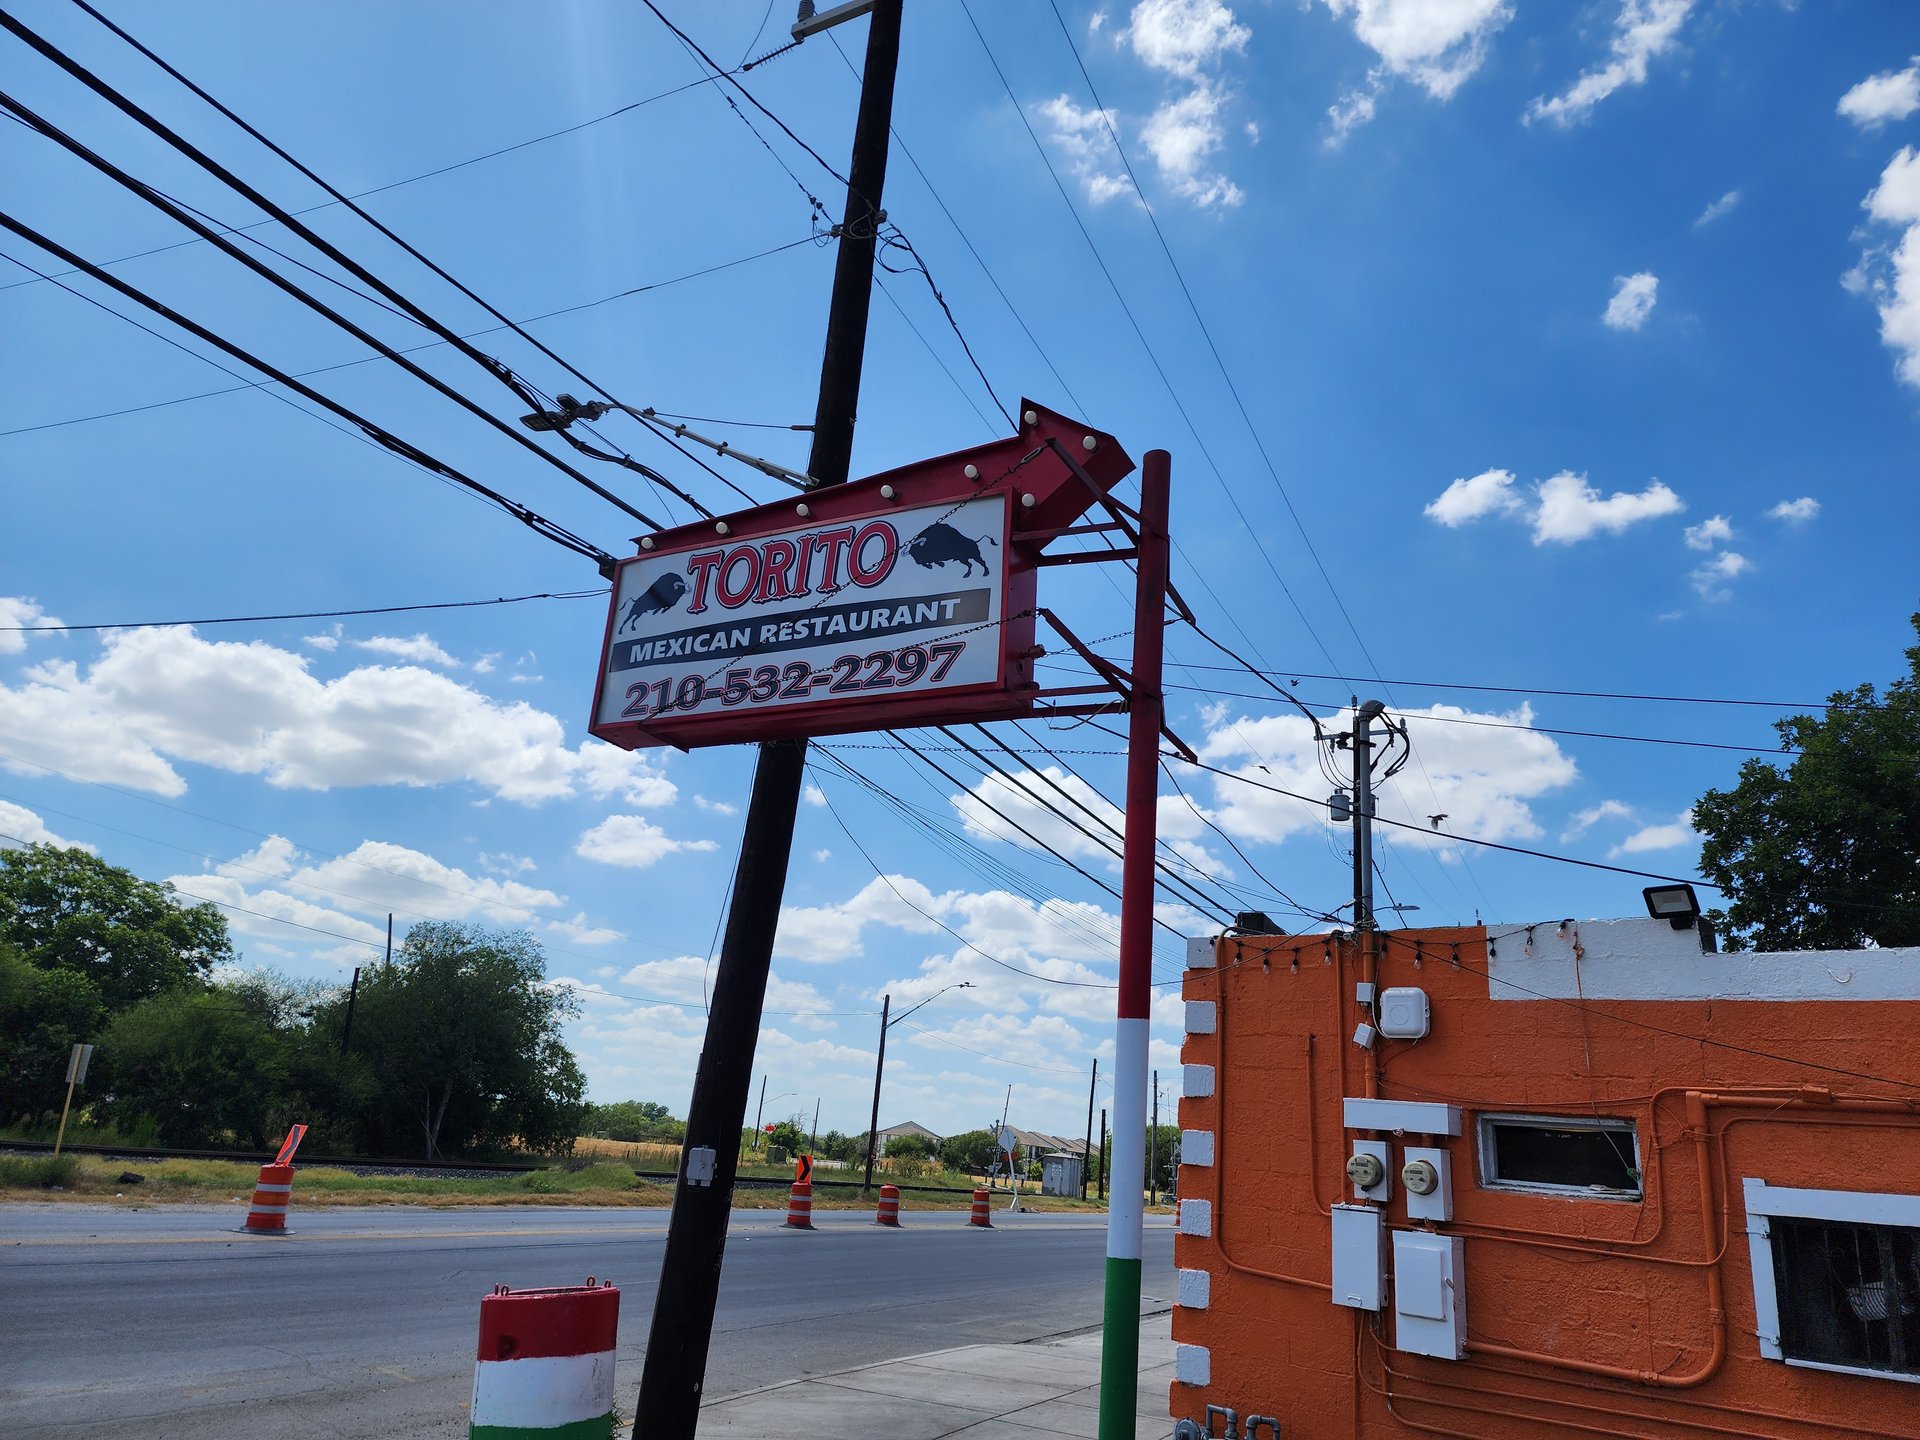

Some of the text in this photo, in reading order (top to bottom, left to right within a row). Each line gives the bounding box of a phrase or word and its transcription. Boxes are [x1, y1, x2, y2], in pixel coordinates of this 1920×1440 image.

[687, 520, 899, 614] TORITO
[629, 598, 961, 663] MEXICAN RESTAURANT
[621, 642, 966, 717] 210-532-2297
